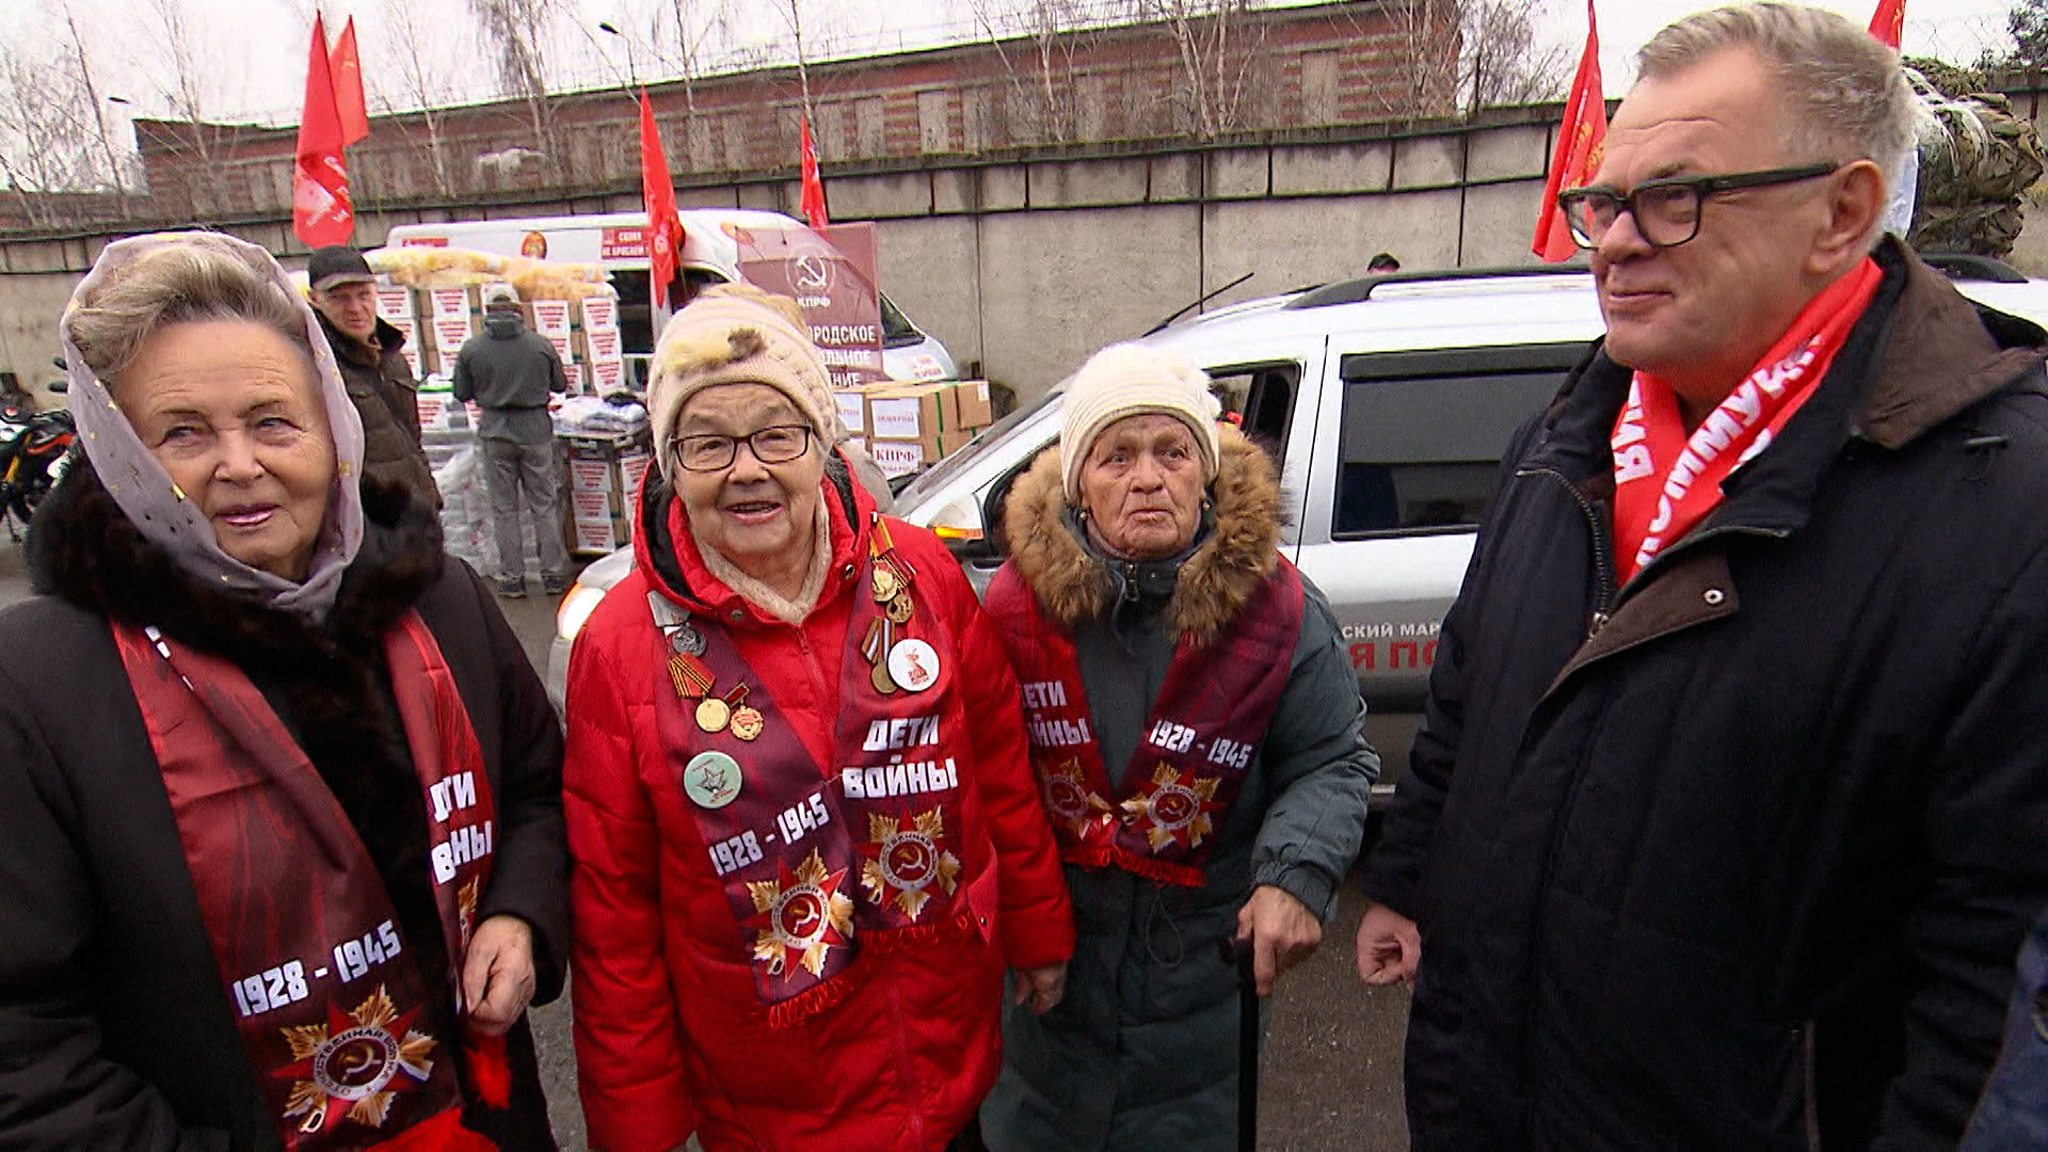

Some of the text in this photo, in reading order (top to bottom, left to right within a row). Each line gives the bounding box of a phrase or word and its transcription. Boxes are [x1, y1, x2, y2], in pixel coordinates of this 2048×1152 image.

[797, 296, 831, 308] КПРФ
[876, 449, 915, 463] КПРФ
[1021, 680, 1068, 708] ЕТИ
[862, 714, 940, 751] ДЕТИ
[1148, 719, 1197, 754] 1928
[1207, 737, 1253, 769] 1945
[842, 754, 959, 799] ВОЙНЫ
[708, 829, 764, 877] 1928
[777, 792, 830, 845] 1945
[232, 958, 309, 1017] 1928
[333, 918, 402, 984] 1945
